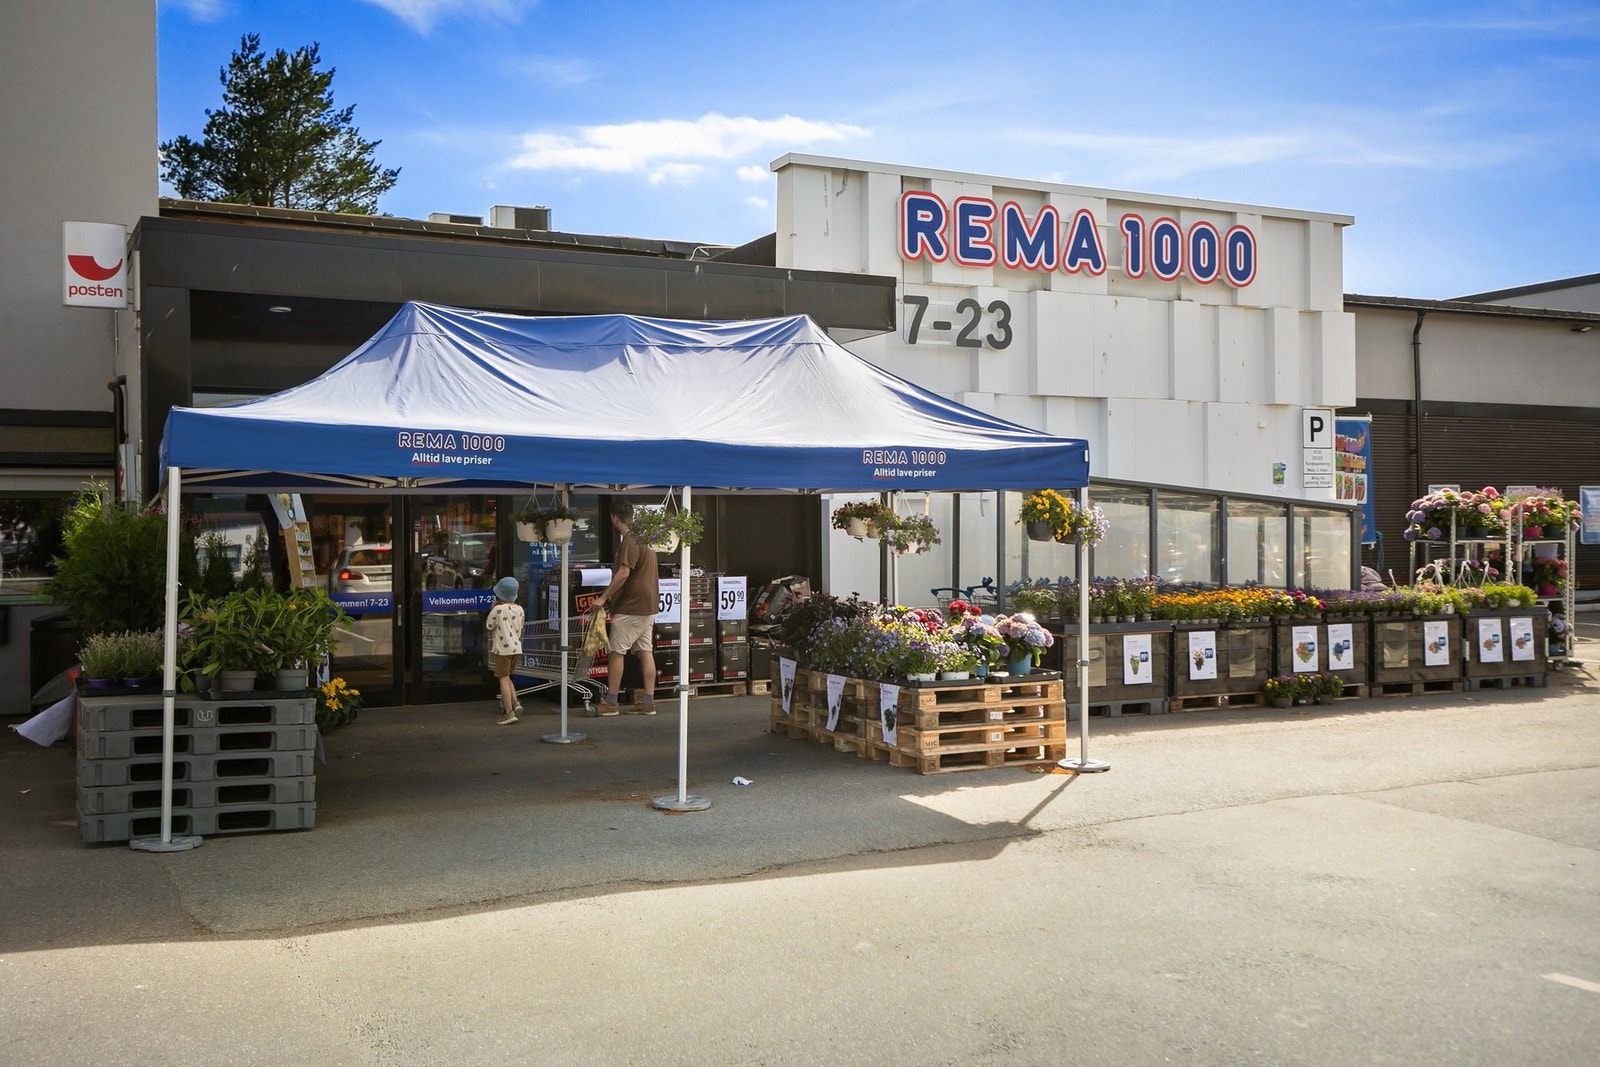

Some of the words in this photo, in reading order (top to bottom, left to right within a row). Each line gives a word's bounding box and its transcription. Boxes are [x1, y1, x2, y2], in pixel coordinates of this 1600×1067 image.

[900, 190, 1107, 278] REMA
[1119, 212, 1257, 289] 1000
[68, 283, 123, 298] posten
[902, 295, 1013, 350] 7-23
[1310, 416, 1324, 442] P
[398, 431, 457, 450] REMA
[462, 434, 506, 452] 1000
[412, 452, 440, 463] Alltid
[442, 453, 463, 464] lave
[463, 454, 492, 466] priser
[862, 449, 909, 465] REMA
[911, 450, 947, 465] 1000
[873, 467, 896, 477] Alltid
[896, 468, 913, 477] lave
[913, 468, 936, 478] priser
[334, 599, 368, 608] ommen!
[369, 598, 389, 607] 7-23
[428, 595, 478, 606] Velkommen!
[478, 595, 497, 604] 7-23
[658, 592, 673, 612] 59
[721, 590, 736, 610] 59
[736, 590, 745, 600] 90
